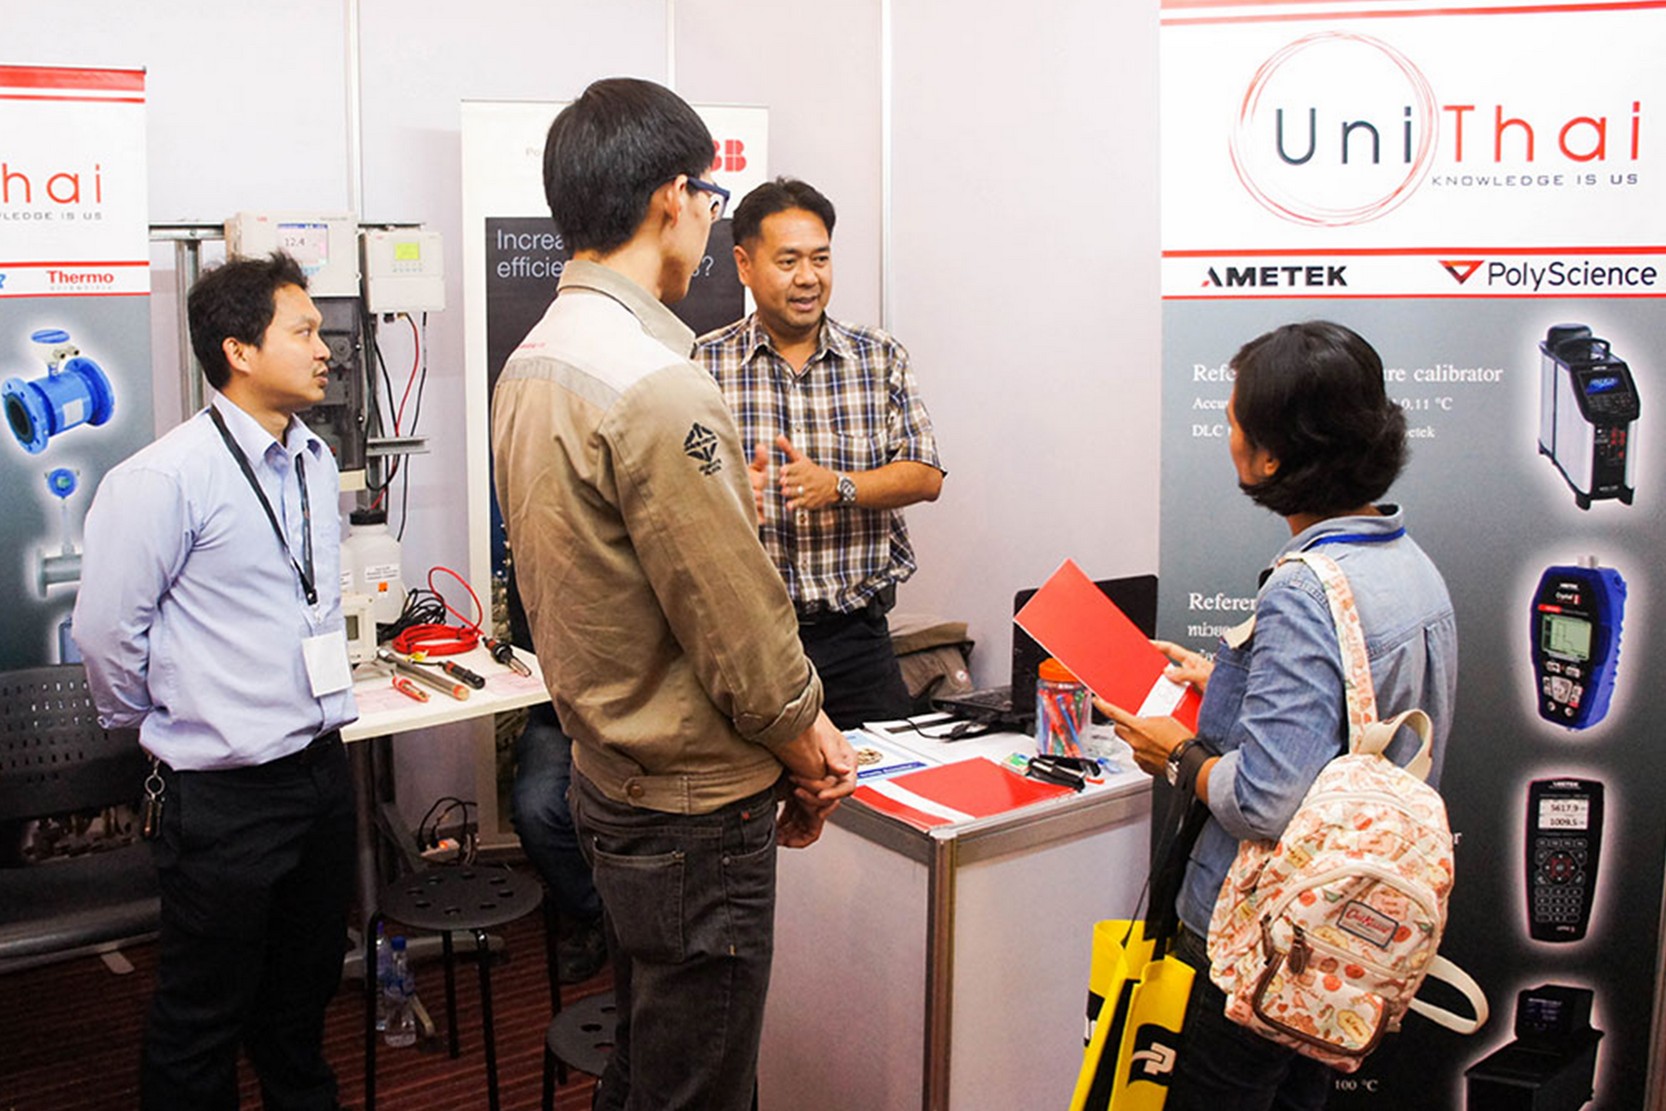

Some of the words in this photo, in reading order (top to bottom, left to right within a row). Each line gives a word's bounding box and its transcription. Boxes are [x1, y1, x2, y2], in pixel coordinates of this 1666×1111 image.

[1432, 175, 1564, 187] KNOWLEDGE
[1576, 174, 1597, 186] IS
[1609, 173, 1638, 186] US
[0, 211, 53, 221] LEDGE
[83, 211, 103, 221] US
[46, 270, 114, 284] Thermo
[1201, 265, 1348, 288] AMETEK
[1488, 260, 1658, 292] PolyScience
[1193, 364, 1237, 382] Refe
[1413, 363, 1504, 382] calibrator
[1192, 424, 1224, 437] DLC
[1405, 425, 1436, 439] etek
[1334, 1079, 1357, 1092] 100
